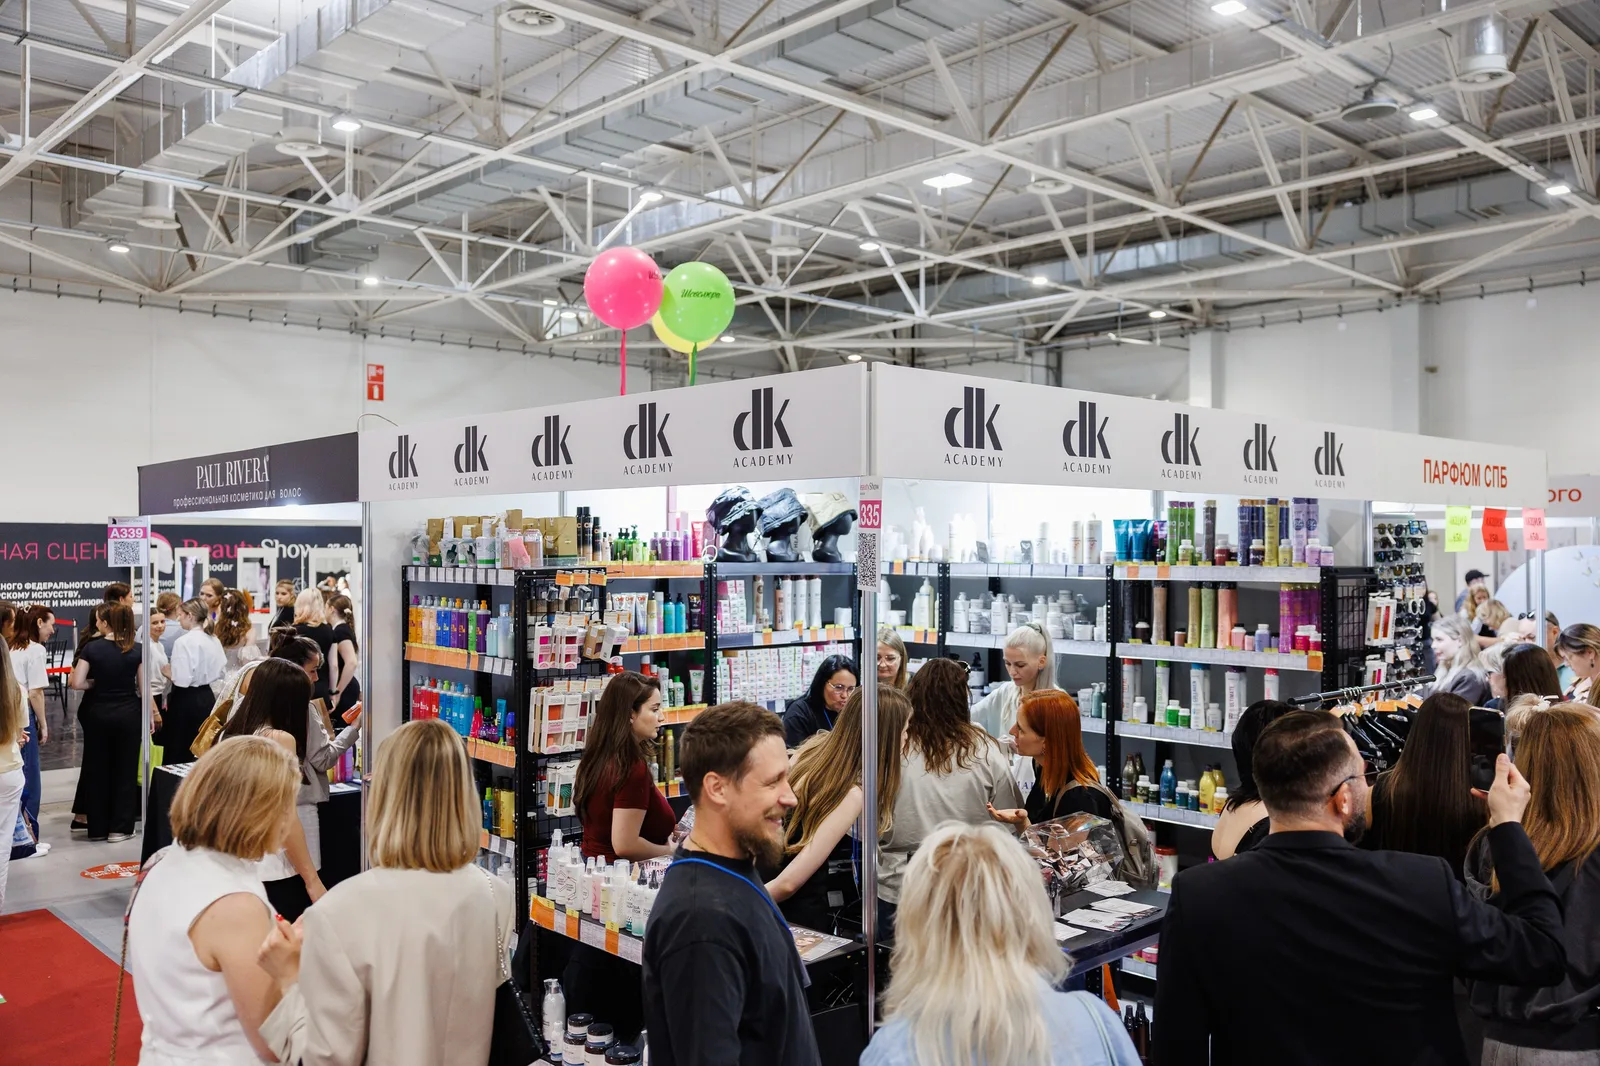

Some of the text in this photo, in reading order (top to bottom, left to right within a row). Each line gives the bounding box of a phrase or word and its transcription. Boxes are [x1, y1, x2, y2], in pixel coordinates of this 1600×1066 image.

[732, 454, 794, 468] ACADEMY
[943, 453, 1004, 467] ACADEMY
[623, 462, 674, 475] ACADEMY
[1062, 462, 1112, 475] ACADEMY
[1423, 459, 1508, 488] ПАРФЮМ СПБ
[196, 463, 224, 489] PAUL
[531, 469, 574, 481] ACADEMY
[1161, 469, 1202, 480] ACADEMY
[1243, 475, 1279, 485] ACADEMY
[388, 481, 419, 490] ACADEMY
[454, 476, 490, 486] ACADEMY
[1314, 481, 1346, 489] ACADEMY
[173, 487, 302, 509] профессиональная косметика для волос
[860, 503, 880, 526] 335
[110, 528, 144, 539] A339
[24, 581, 90, 590] ФЕДЕРАЛЬНОГО
[91, 580, 120, 589] ОКР
[0, 590, 81, 600] СКОМУ ИСКУССТВУ,
[52, 599, 59, 607] И
[60, 598, 104, 607] МАНИКЮР
